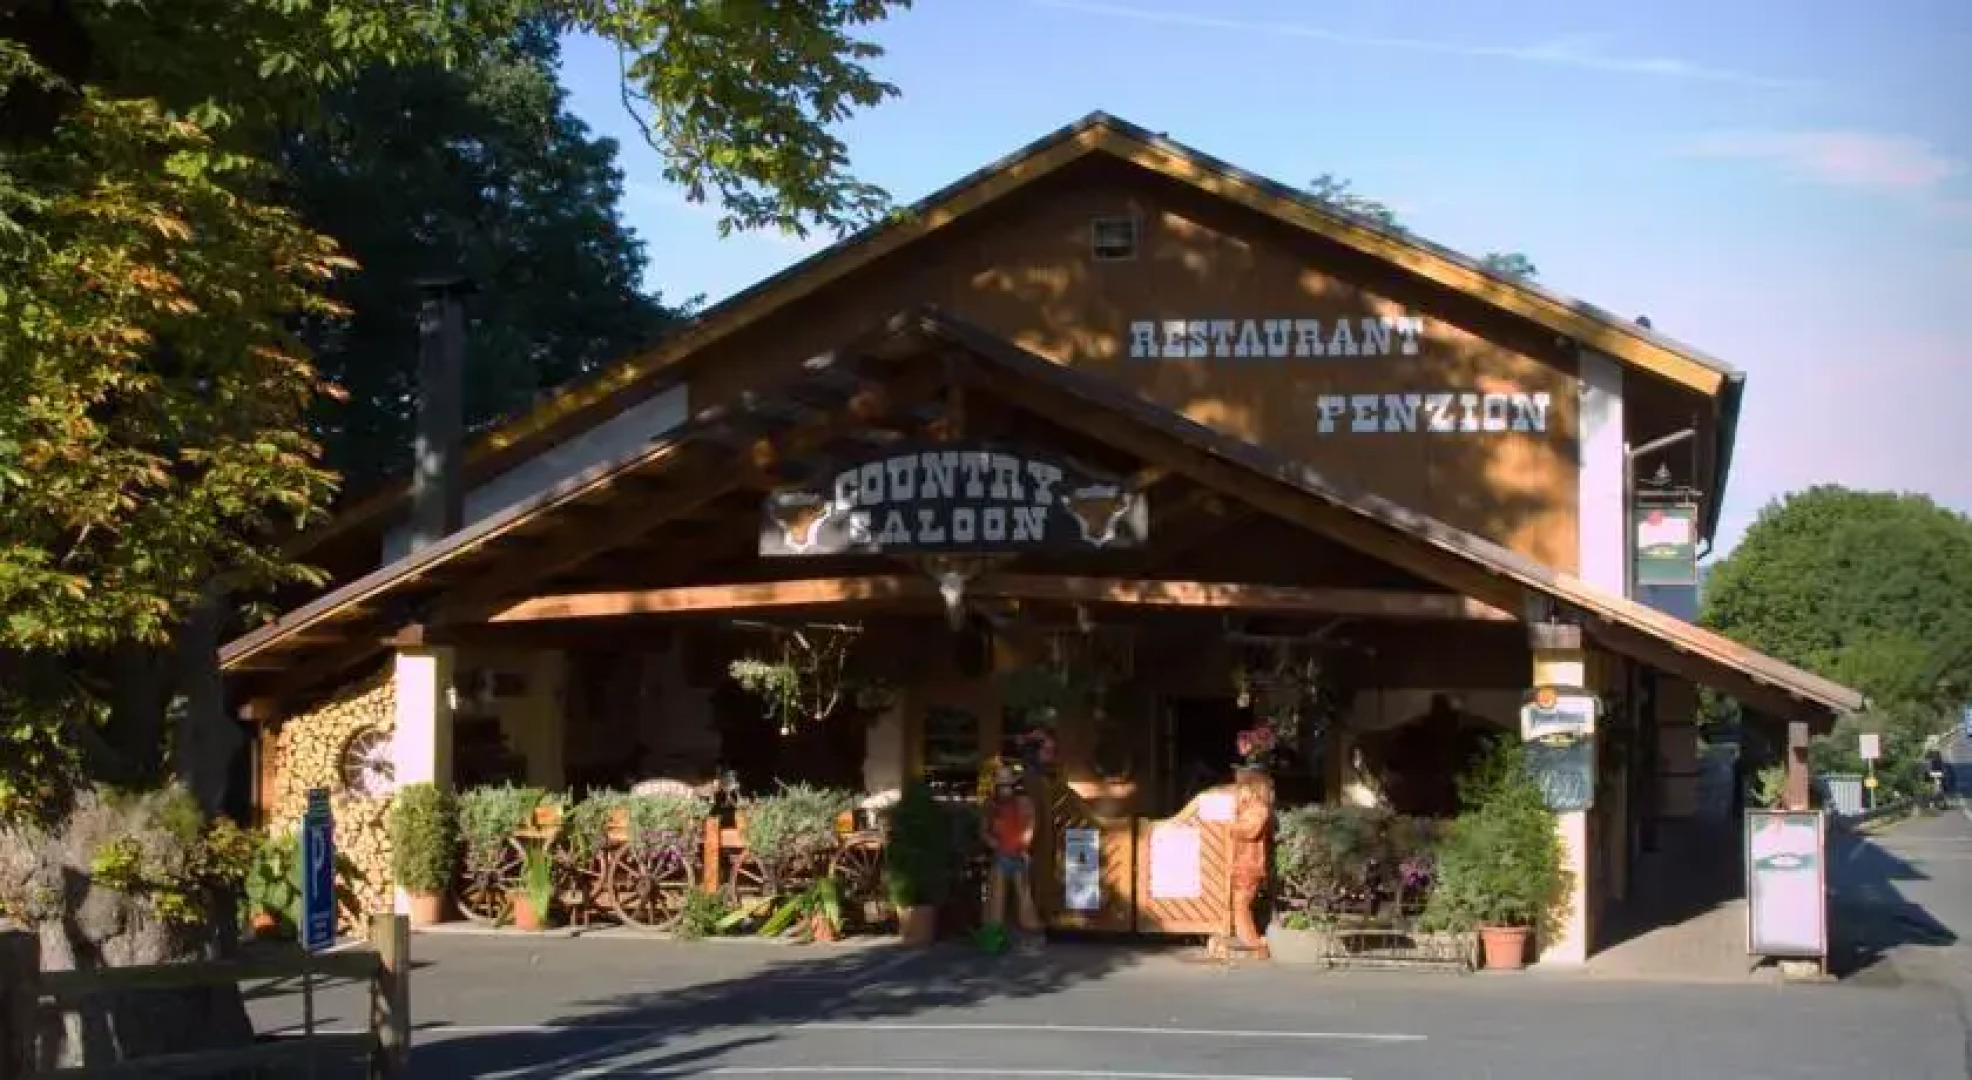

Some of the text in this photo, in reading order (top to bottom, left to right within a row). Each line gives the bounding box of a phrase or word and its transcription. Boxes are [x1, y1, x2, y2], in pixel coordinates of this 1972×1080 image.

[1130, 318, 1424, 358] RESTAURANT
[1316, 392, 1551, 433] PENZION
[835, 451, 1063, 511] COUNTRY
[849, 506, 1048, 543] SALOON
